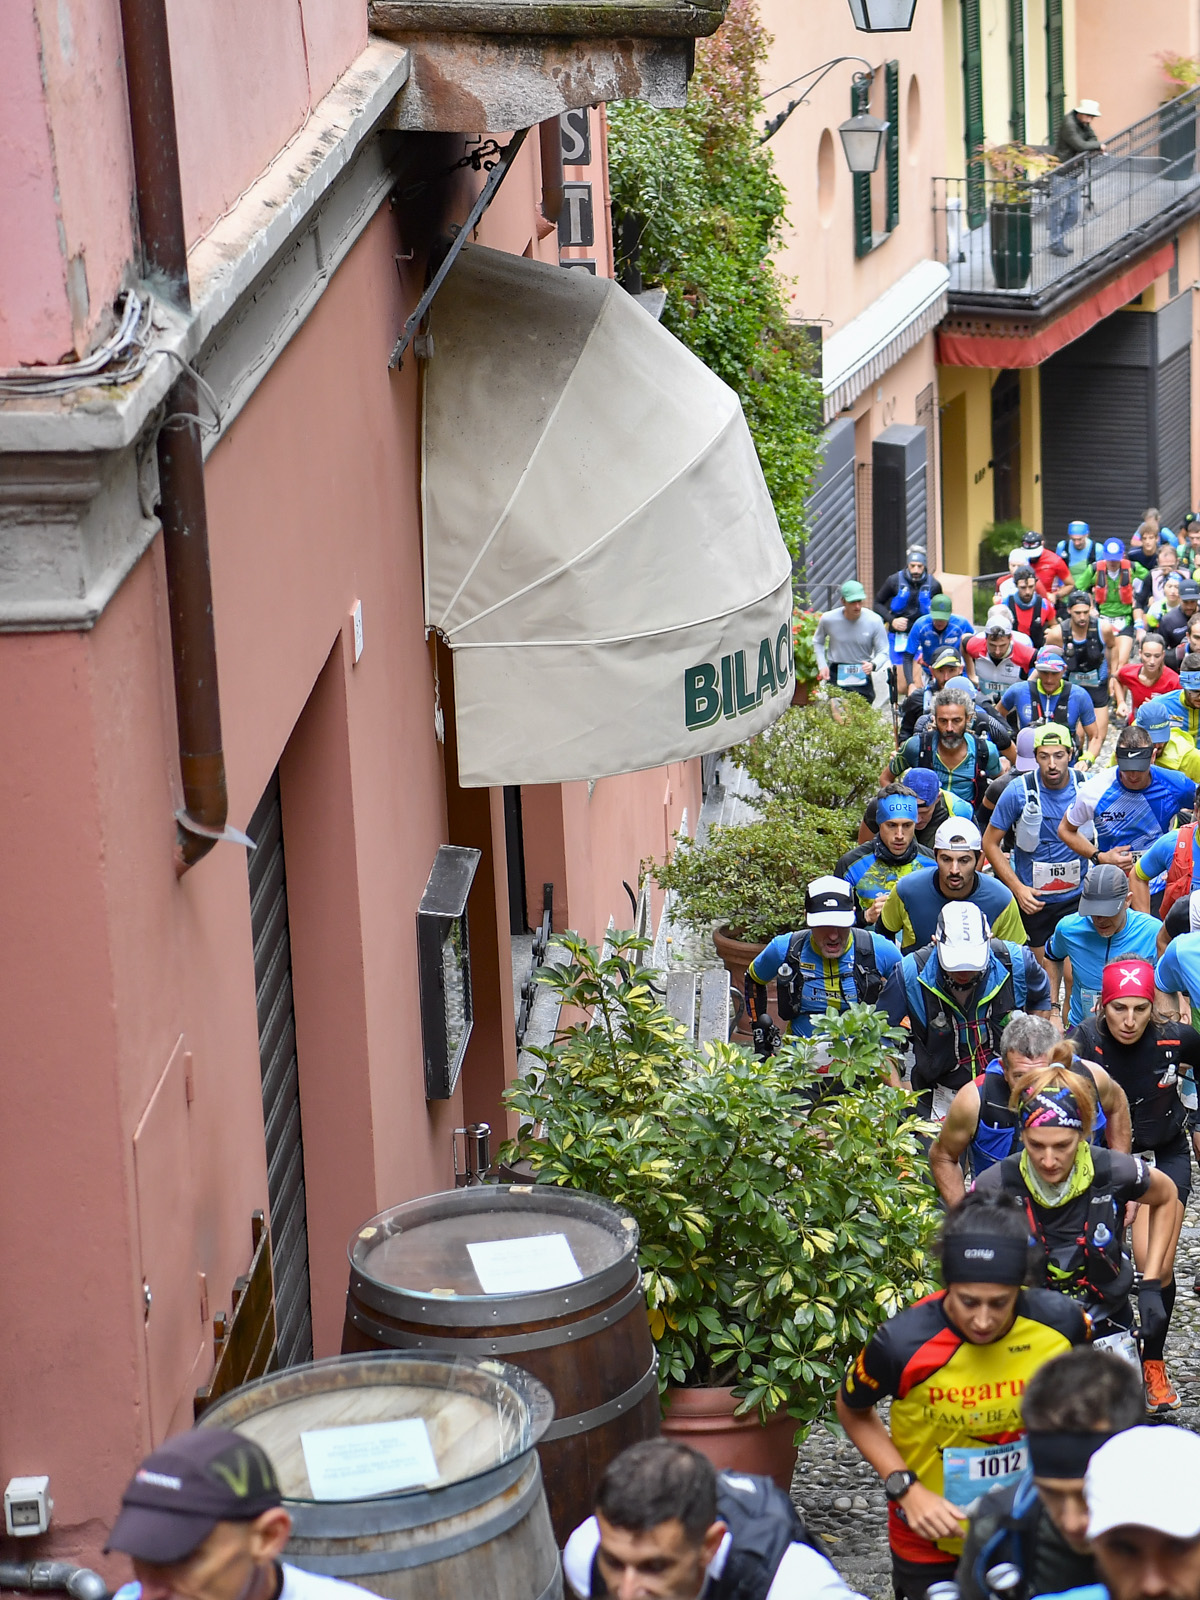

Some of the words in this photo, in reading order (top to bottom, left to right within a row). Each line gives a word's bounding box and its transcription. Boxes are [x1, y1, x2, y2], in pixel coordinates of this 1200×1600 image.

[889, 803, 913, 812] GORE
[1049, 867, 1066, 877] 163
[922, 1404, 965, 1425] TEAM
[978, 1451, 1022, 1477] 1012
